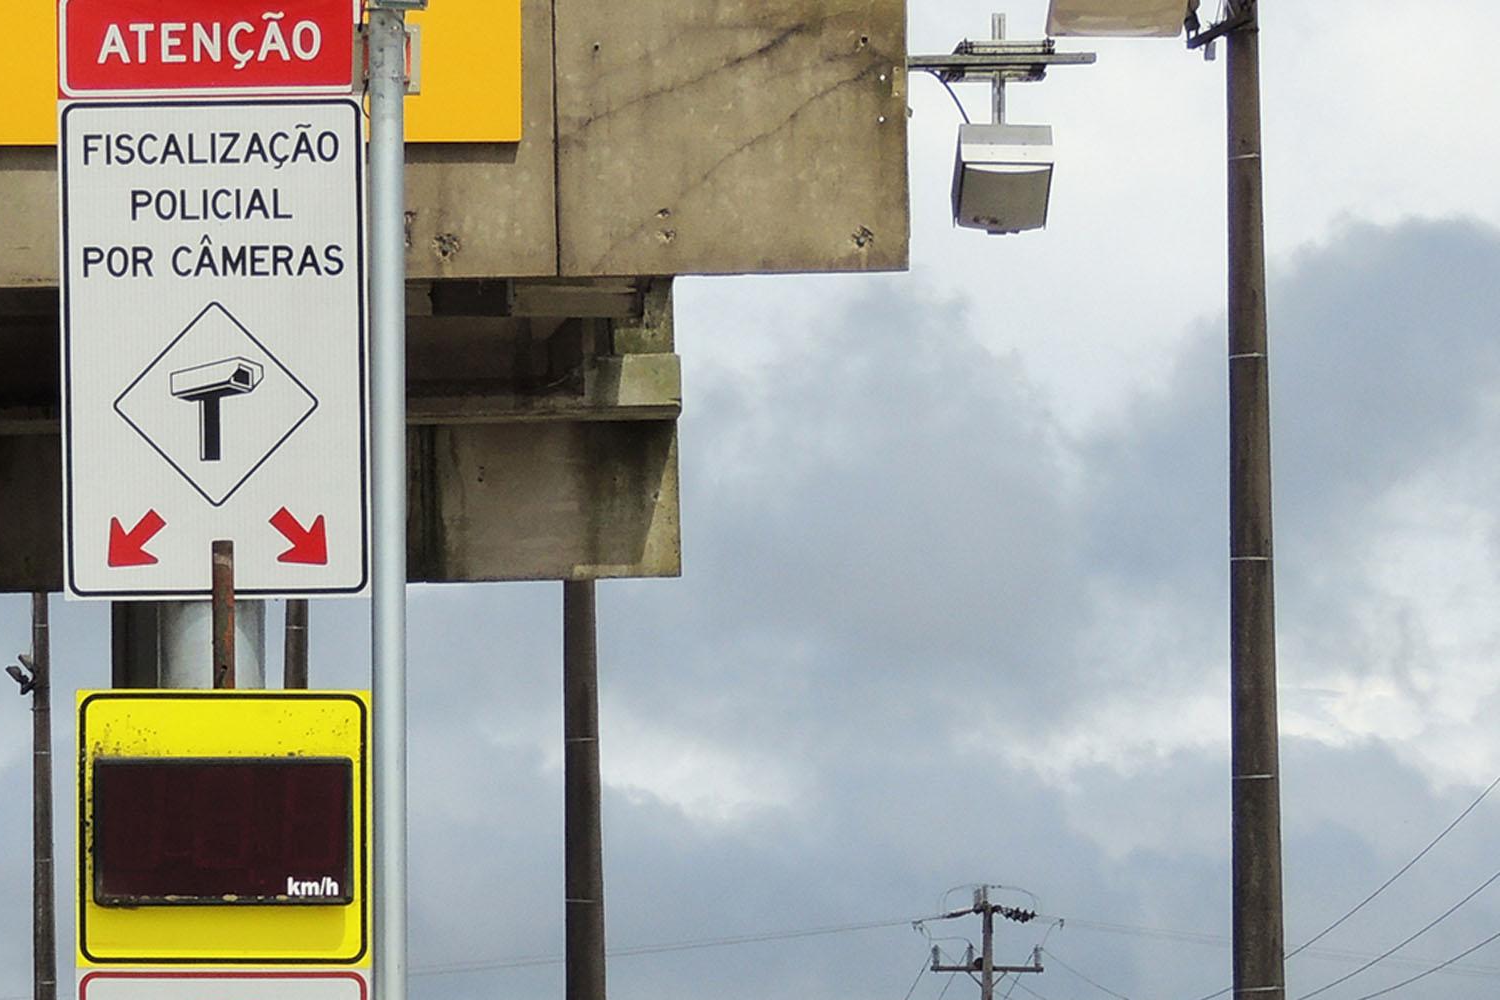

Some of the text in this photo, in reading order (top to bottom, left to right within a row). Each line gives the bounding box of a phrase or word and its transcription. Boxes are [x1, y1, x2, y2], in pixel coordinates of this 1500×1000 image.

[97, 10, 322, 70] ATENÇÃO
[82, 123, 340, 169] FISCALIZAÇÃO
[131, 188, 293, 221] POLICIAL
[82, 234, 345, 279] POR CÂMERAS
[286, 877, 339, 899] km/h
